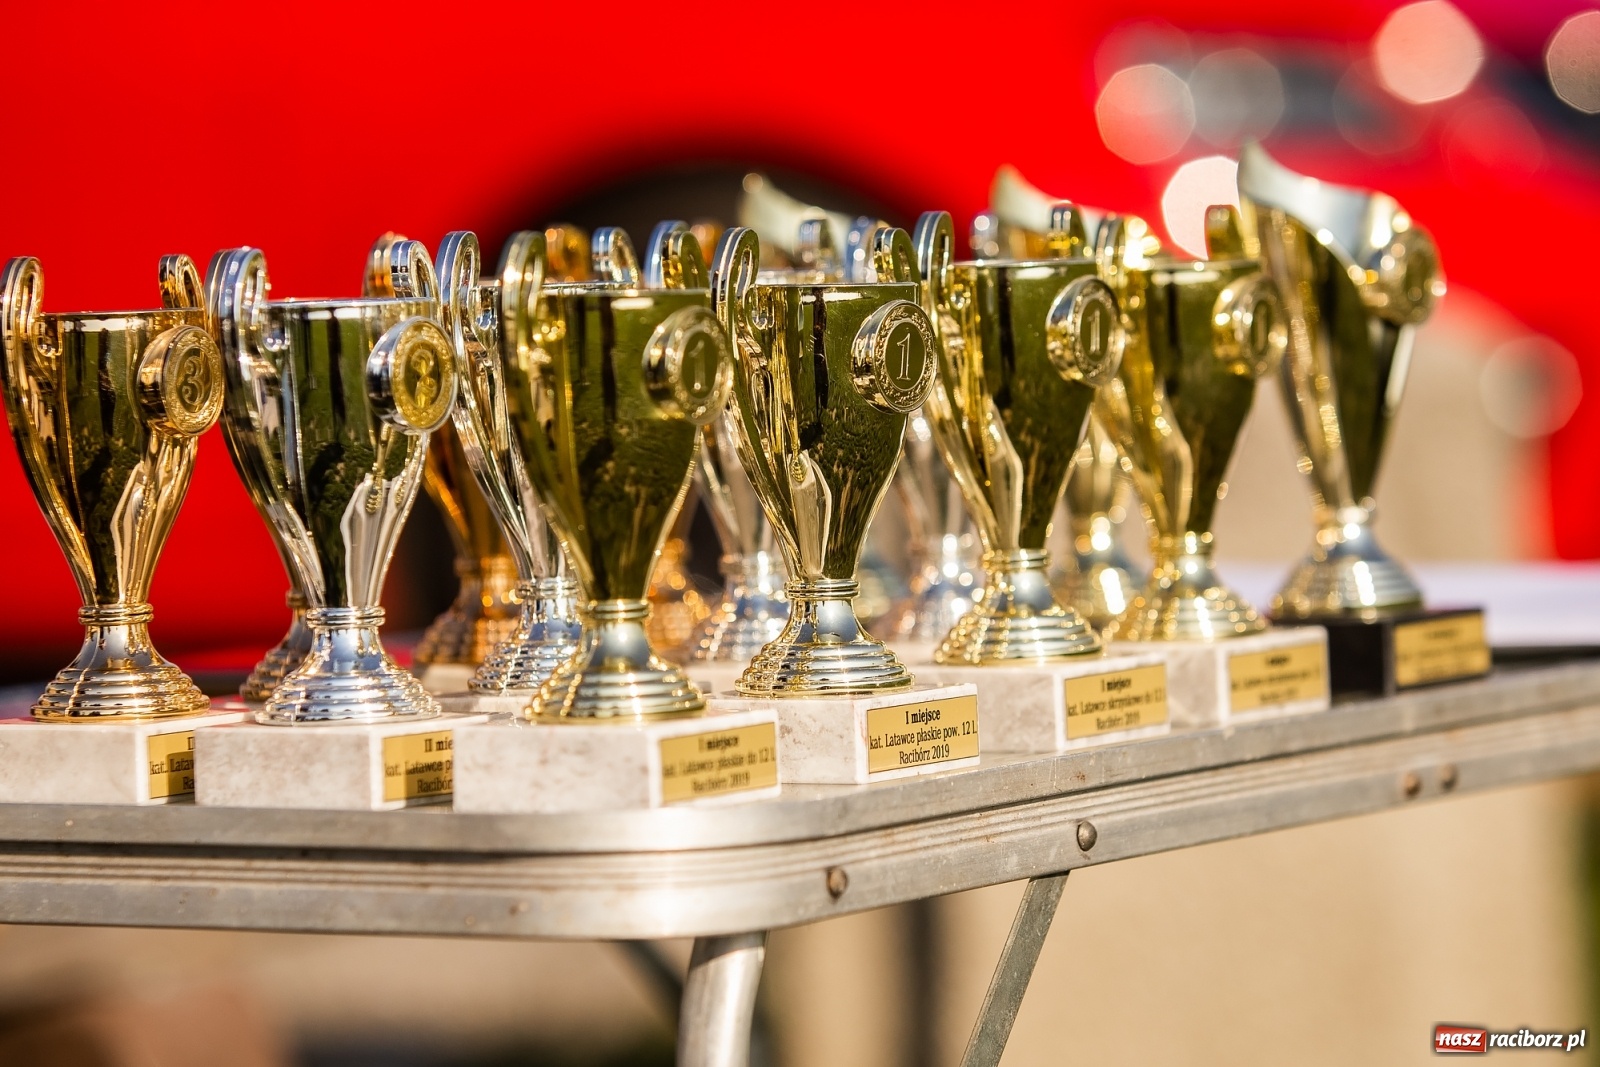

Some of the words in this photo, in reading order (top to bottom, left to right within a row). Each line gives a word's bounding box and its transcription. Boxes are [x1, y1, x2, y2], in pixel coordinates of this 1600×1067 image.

[1087, 309, 1100, 355] 1
[688, 340, 708, 392] 1
[896, 332, 911, 380] 1
[181, 355, 204, 405] 3
[905, 710, 909, 725] I
[911, 708, 941, 725] miejsce
[424, 738, 433, 753] II
[869, 735, 884, 750] kat.
[885, 731, 915, 748] Latawce
[916, 726, 942, 746] płaskie
[943, 725, 960, 742] pow.
[962, 721, 971, 736] 12
[899, 747, 931, 765] Racibórz
[932, 743, 950, 760] 2019
[149, 761, 168, 776] kat.
[383, 763, 402, 778] kat.
[404, 759, 443, 776] Latawce
